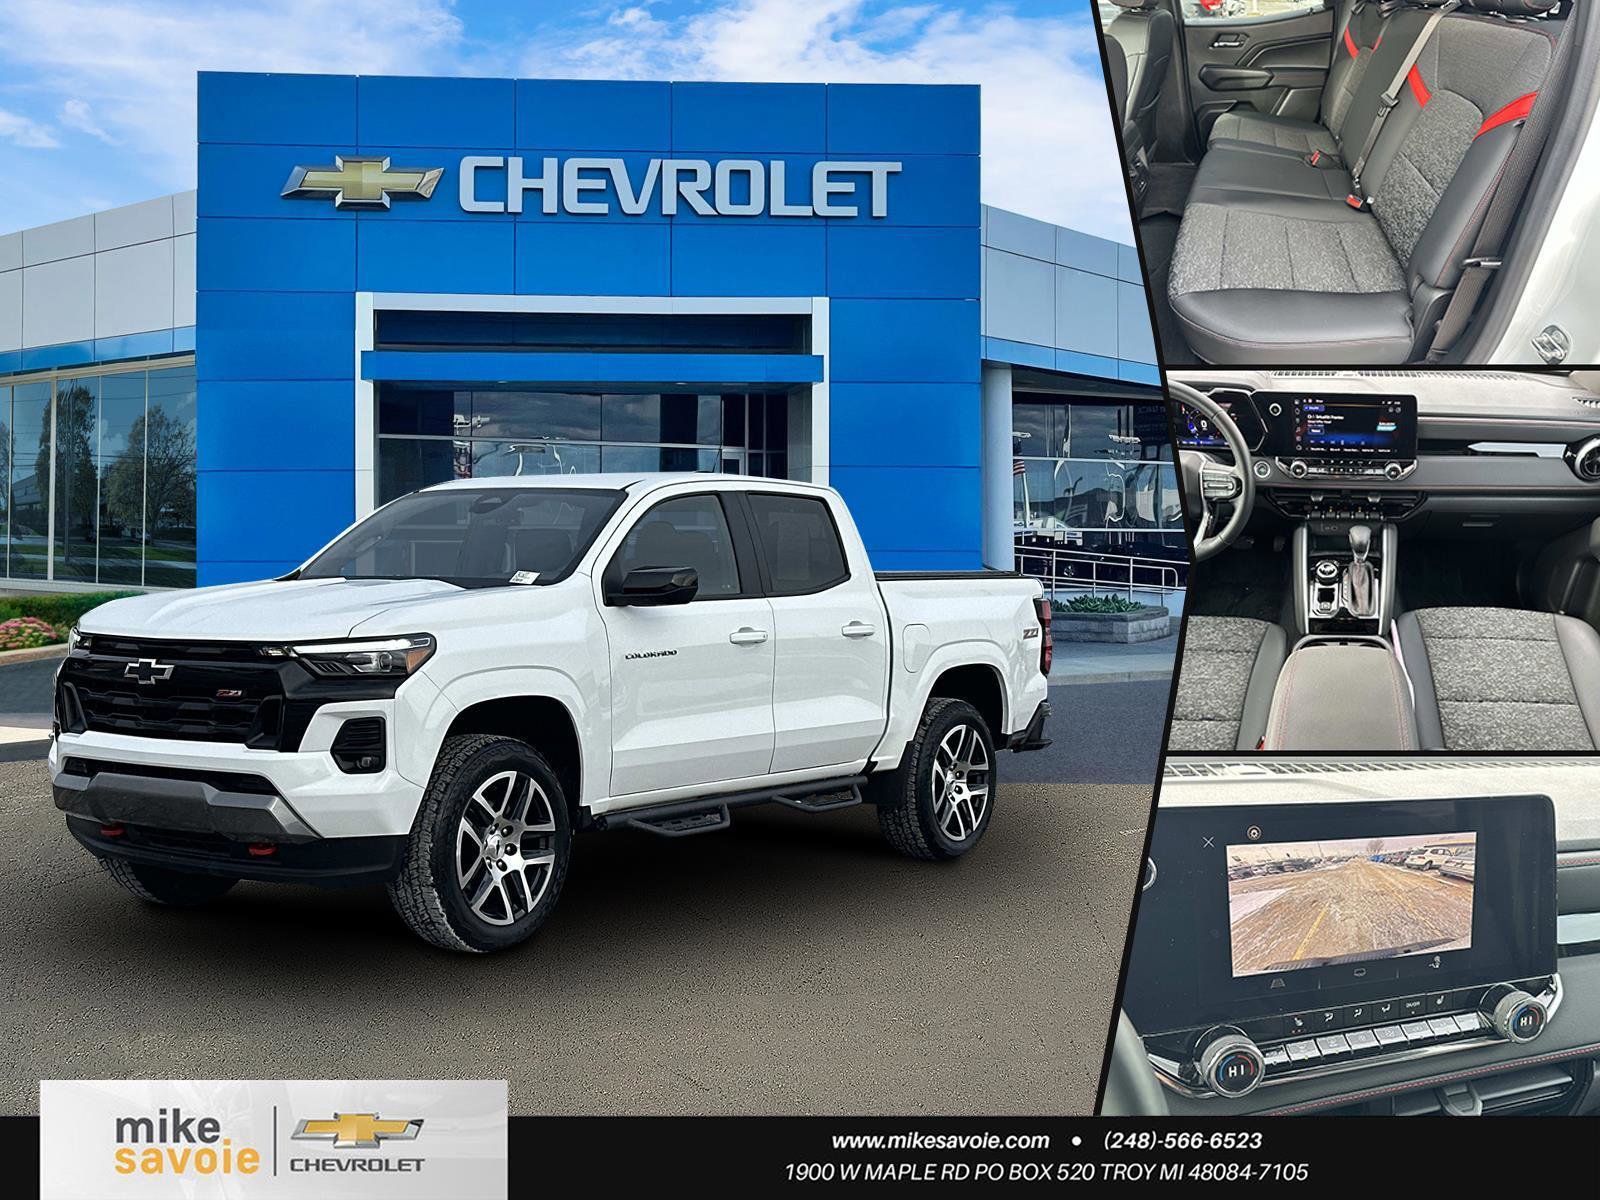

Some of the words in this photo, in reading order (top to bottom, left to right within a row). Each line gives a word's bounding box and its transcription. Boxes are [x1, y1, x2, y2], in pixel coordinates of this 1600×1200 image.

[459, 155, 903, 217] CHEVROLET
[1520, 1015, 1533, 1027] HI
[1228, 1064, 1245, 1078] HI
